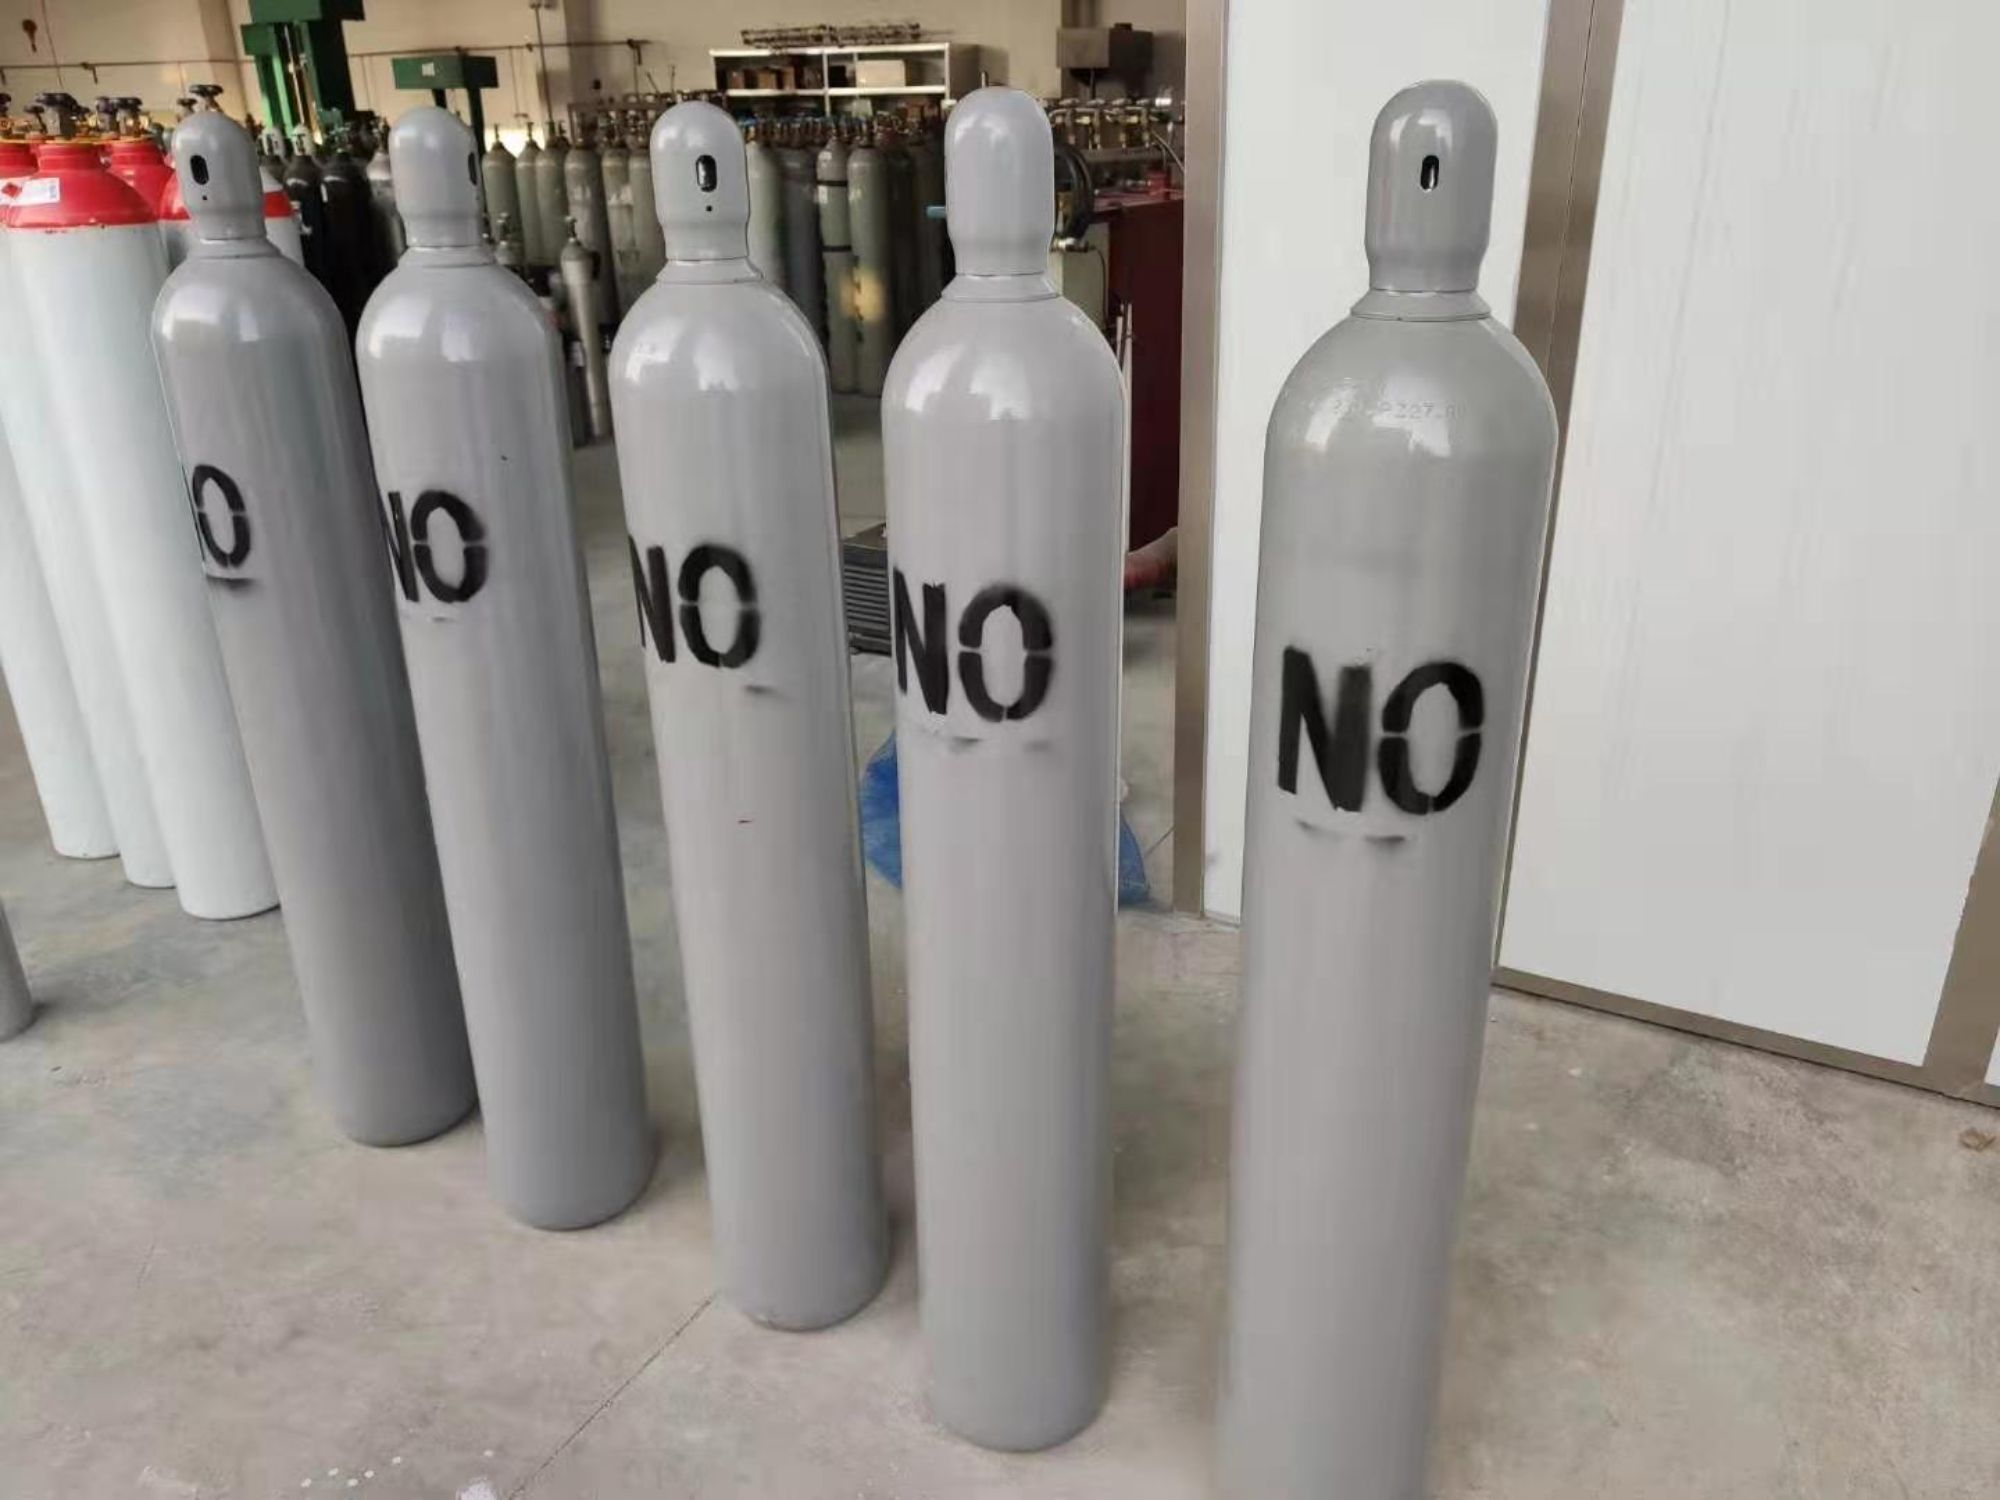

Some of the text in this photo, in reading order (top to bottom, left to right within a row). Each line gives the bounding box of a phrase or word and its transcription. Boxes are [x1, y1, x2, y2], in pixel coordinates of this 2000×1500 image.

[183, 463, 250, 568] O
[386, 489, 487, 603] NO
[628, 535, 761, 668] NO
[894, 567, 1053, 722] NO
[1278, 645, 1484, 815] NO
